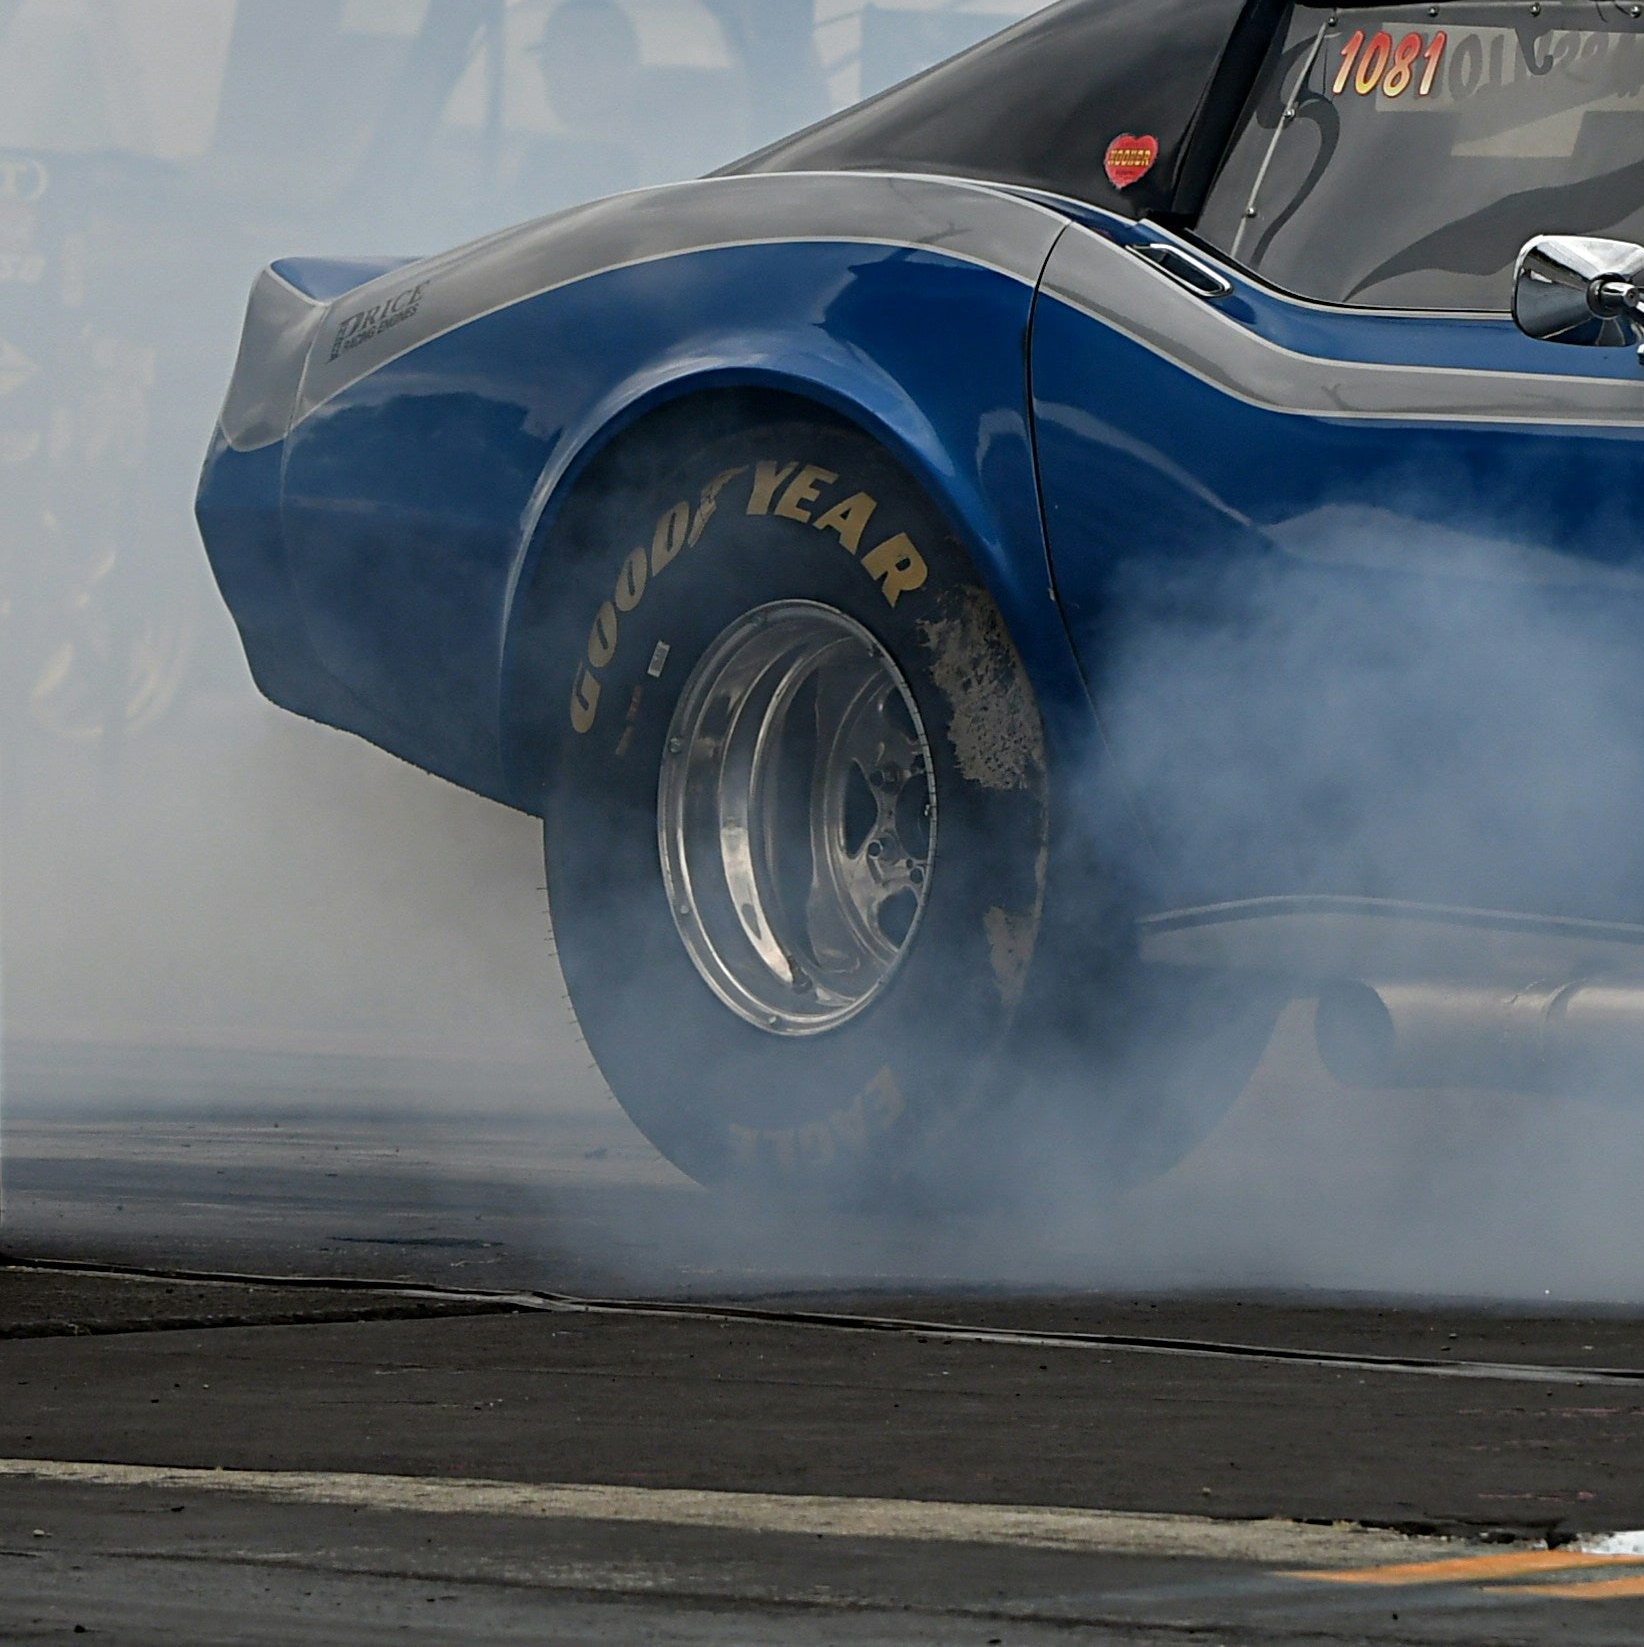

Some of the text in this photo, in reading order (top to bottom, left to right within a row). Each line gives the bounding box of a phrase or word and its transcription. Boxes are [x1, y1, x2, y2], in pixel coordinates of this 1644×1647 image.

[1332, 30, 1447, 98] 1081
[326, 280, 430, 364] PRICE
[570, 459, 930, 734] GOODYEAR
